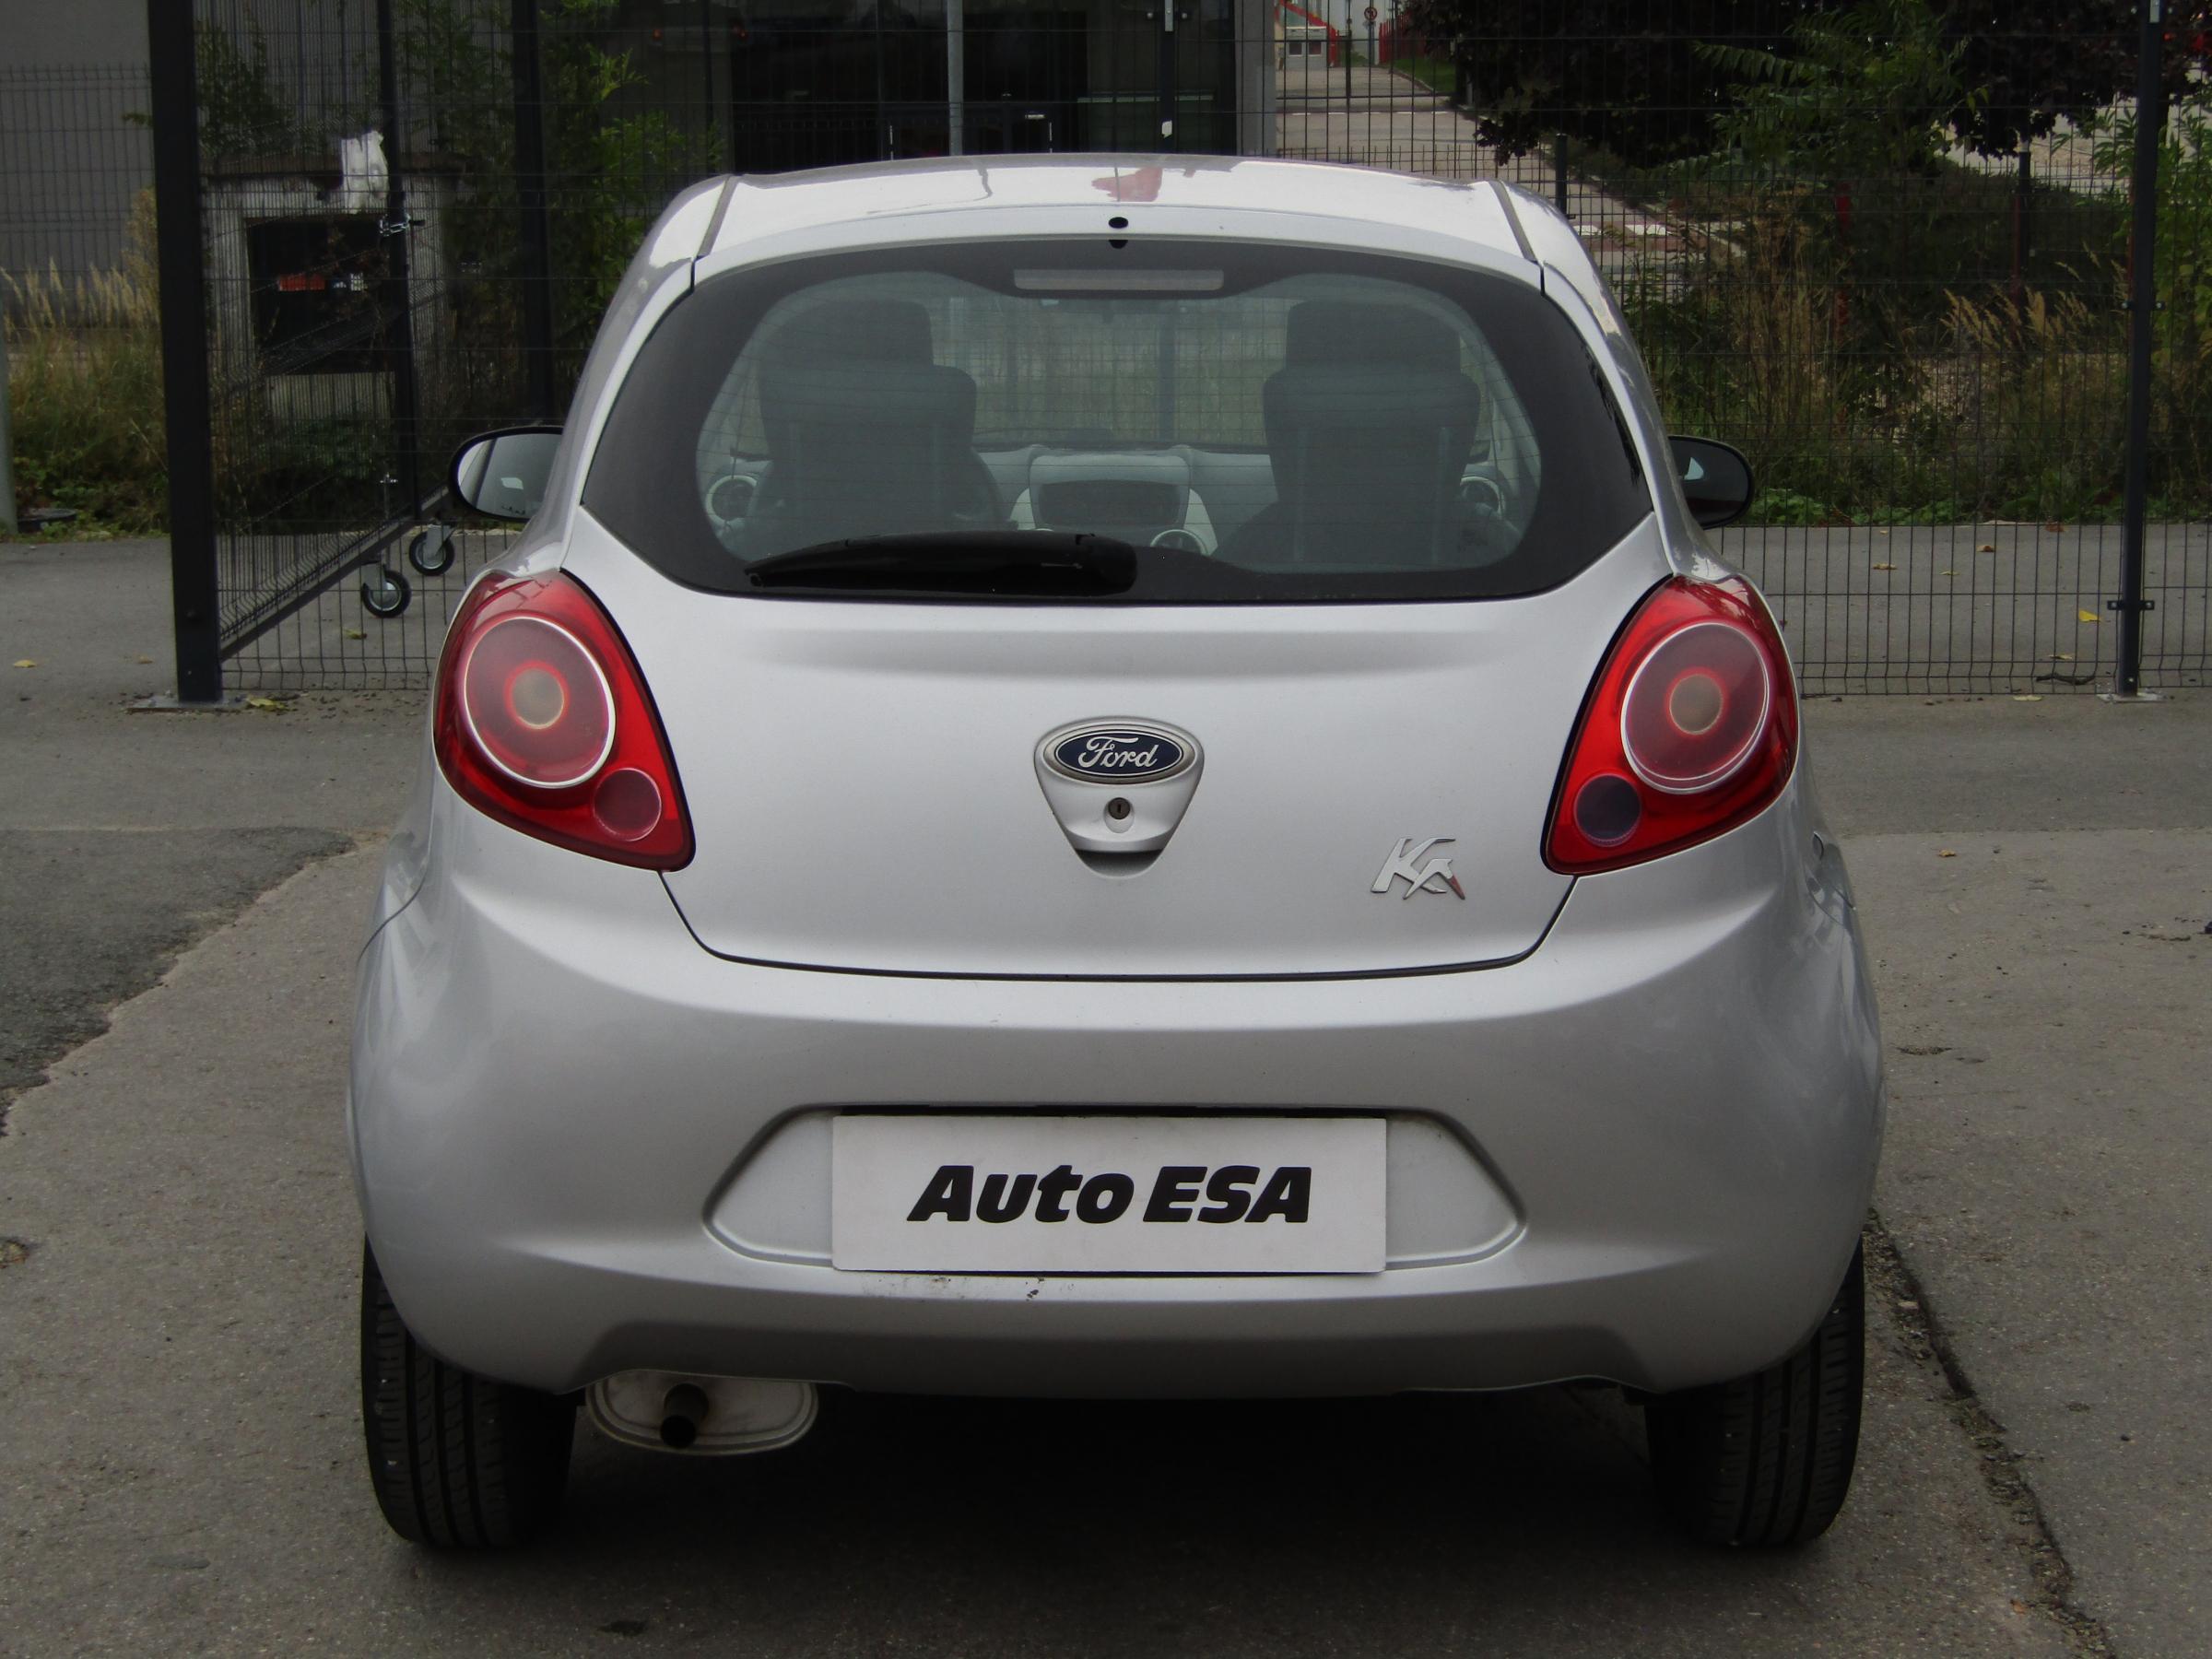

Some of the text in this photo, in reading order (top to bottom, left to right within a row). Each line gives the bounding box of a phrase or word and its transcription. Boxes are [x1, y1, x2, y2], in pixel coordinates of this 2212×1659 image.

[1077, 735, 1159, 768] Ford
[906, 1164, 1312, 1224] Auto ESA
